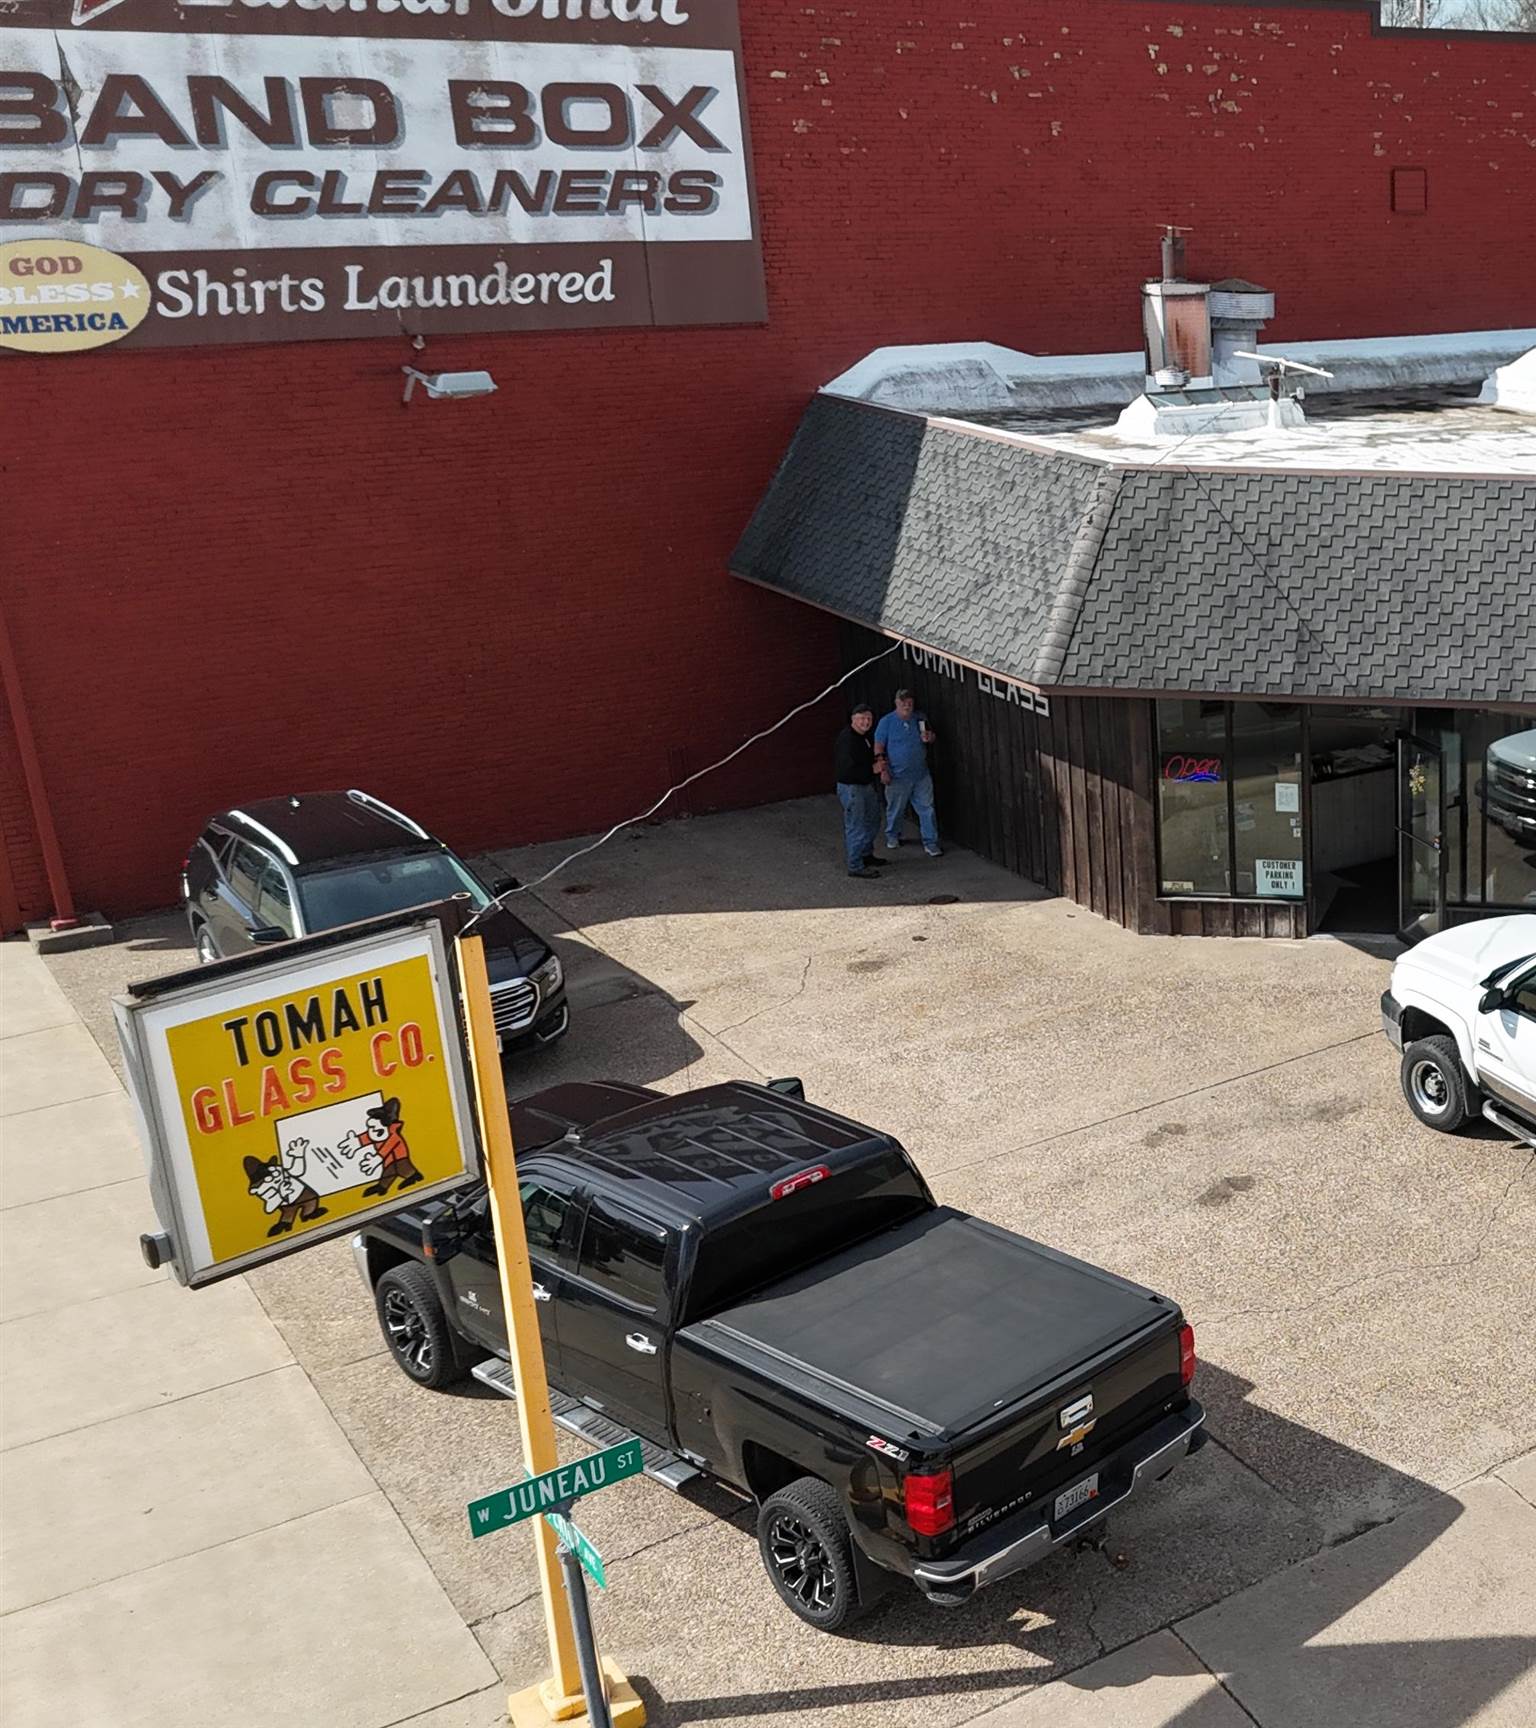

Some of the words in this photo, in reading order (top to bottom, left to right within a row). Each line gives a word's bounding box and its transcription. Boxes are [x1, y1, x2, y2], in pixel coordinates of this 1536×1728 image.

[0, 71, 404, 149] BAND
[448, 79, 732, 153] BOX
[0, 170, 224, 223] DRY
[250, 169, 722, 219] CLEANERS
[9, 256, 83, 276] GOD
[156, 267, 326, 318] Shirts
[343, 258, 615, 310] Laundered
[0, 312, 128, 334] MERICA
[976, 671, 1050, 718] GLASS
[1262, 861, 1296, 870] CUSTOMER
[1265, 871, 1294, 879] PARKING
[1271, 880, 1288, 888] ONLY
[223, 977, 389, 1067] TOMAH
[191, 1048, 348, 1135] GLASS
[371, 1022, 436, 1077] CO.
[476, 1507, 491, 1524] W
[503, 1456, 607, 1521] JUNEAU
[616, 1451, 635, 1469] ST
